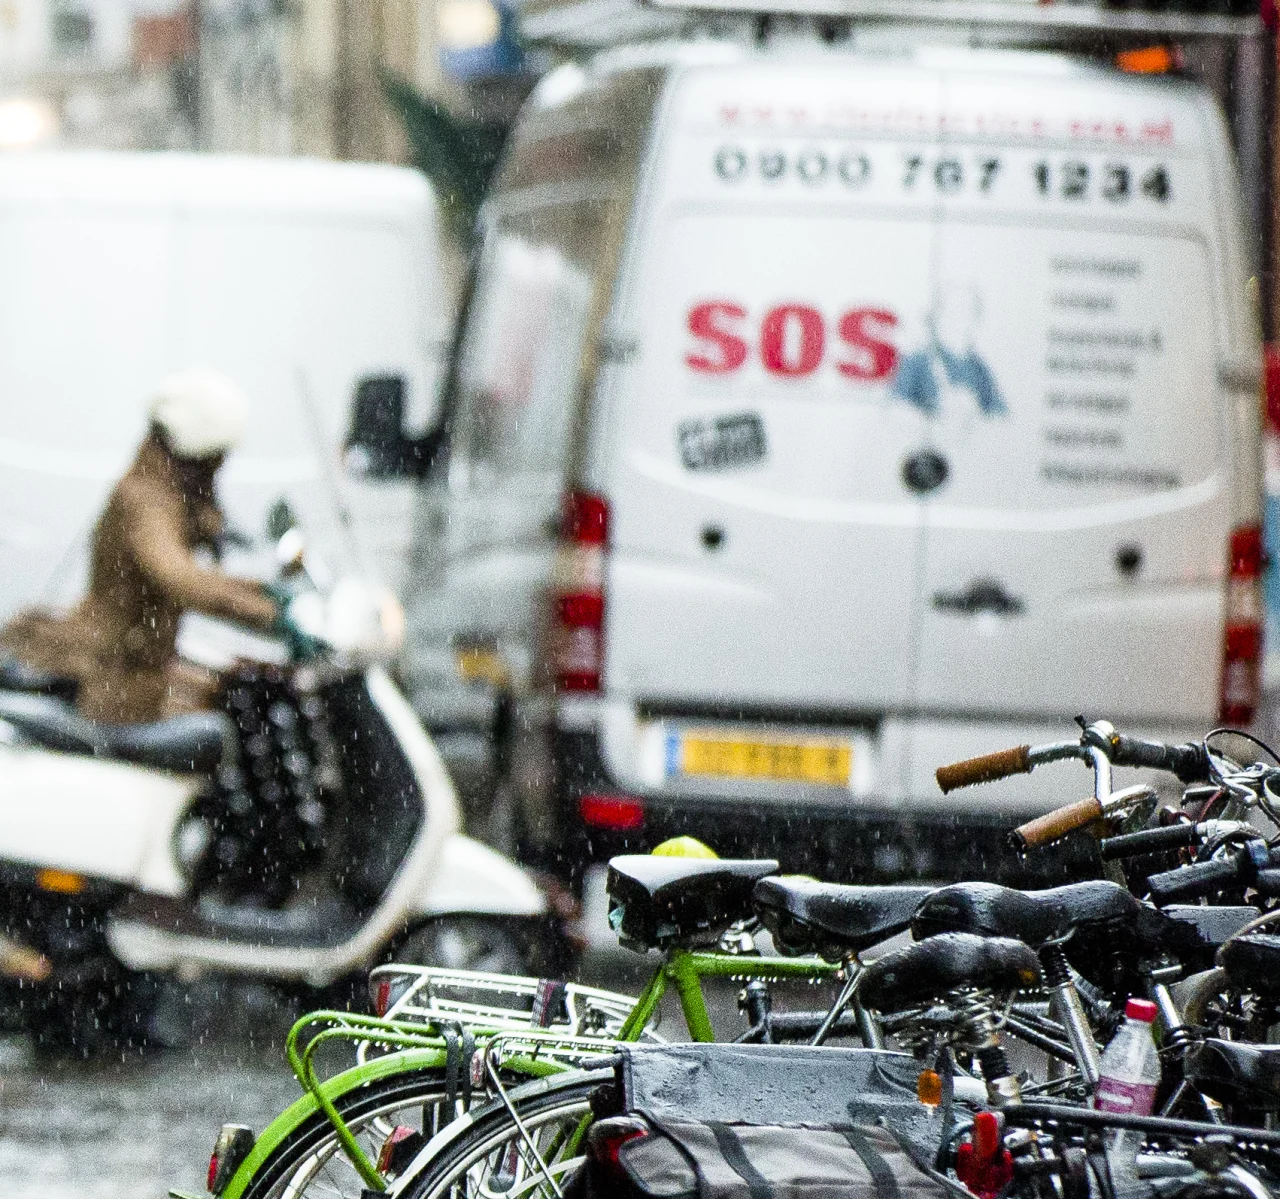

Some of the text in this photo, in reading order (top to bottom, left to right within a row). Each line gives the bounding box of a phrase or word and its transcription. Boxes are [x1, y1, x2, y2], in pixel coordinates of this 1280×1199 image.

[713, 143, 1172, 205] 0900 767 1234
[683, 299, 900, 382] SOS
